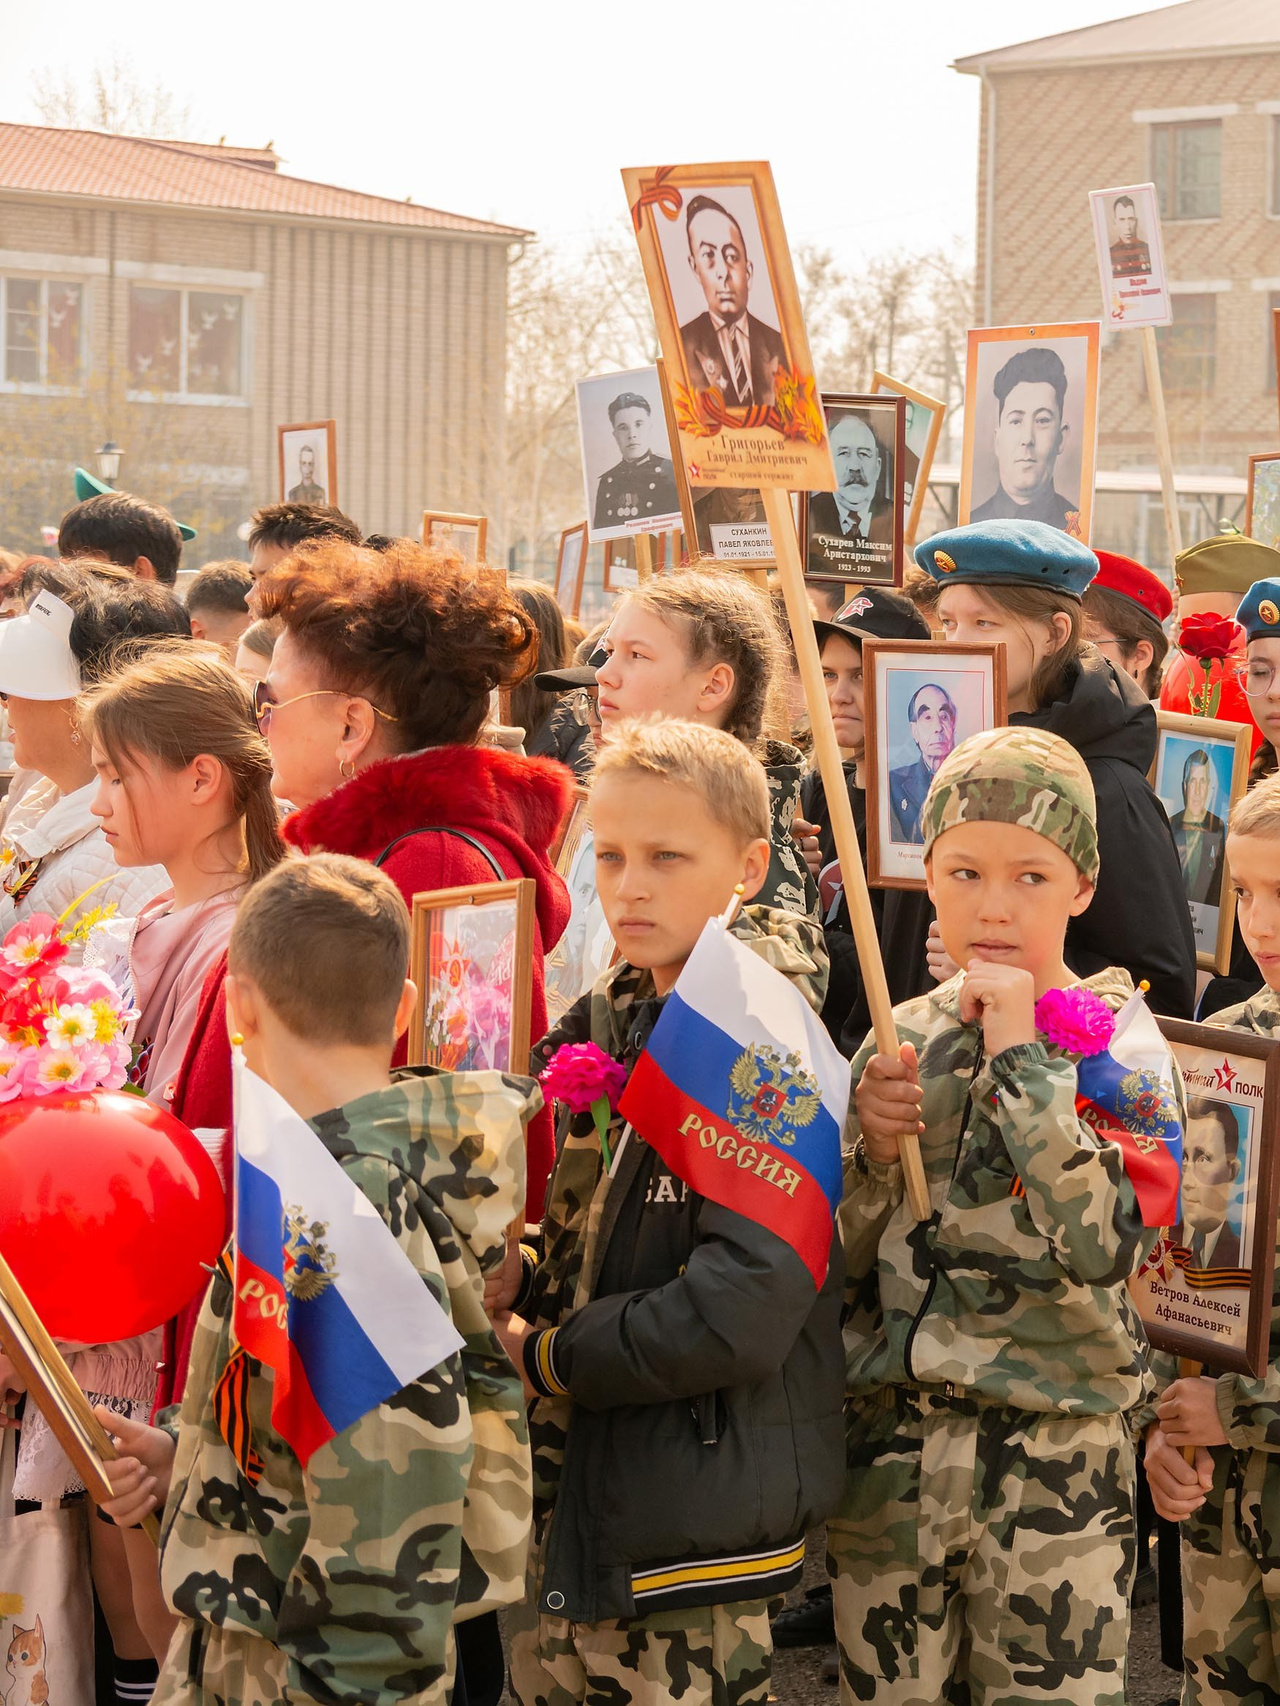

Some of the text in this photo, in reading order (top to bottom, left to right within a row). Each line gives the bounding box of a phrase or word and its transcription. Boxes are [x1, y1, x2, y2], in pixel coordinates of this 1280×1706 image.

[721, 435, 785, 454] Григорьев
[706, 450, 808, 467] Гаврил Дмитриевич
[731, 528, 767, 536] СУХАНКИН
[818, 536, 893, 551] Сухарев Максим
[823, 549, 887, 563] Аристархович
[838, 563, 852, 571] 1923
[1235, 1081, 1264, 1098] ПОЛК
[677, 1113, 803, 1198] РОССИЯ
[1150, 1281, 1241, 1317] Ветров Алексей
[1155, 1303, 1233, 1336] Афанасьевич
